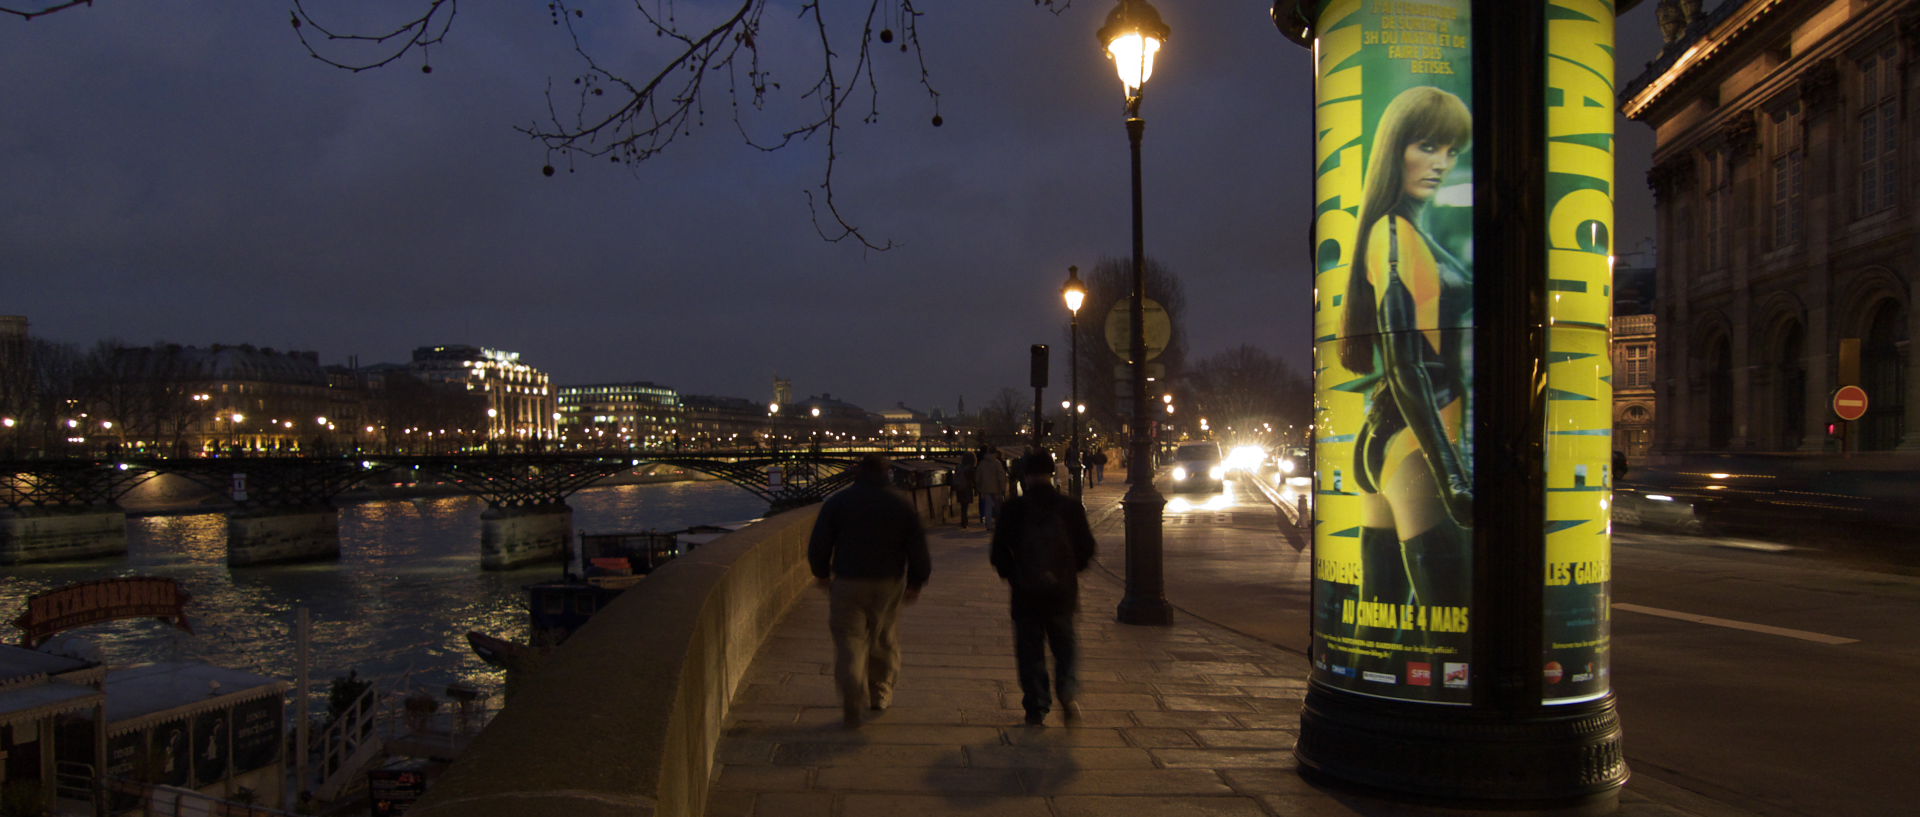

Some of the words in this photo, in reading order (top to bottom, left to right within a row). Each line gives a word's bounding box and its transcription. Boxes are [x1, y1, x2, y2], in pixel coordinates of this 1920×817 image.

[1381, 16, 1395, 29] DE
[1364, 31, 1379, 45] 3H
[1381, 31, 1398, 45] DU
[1440, 34, 1450, 47] ET
[1453, 36, 1466, 48] DE
[1388, 45, 1420, 59] FAIRE
[1422, 46, 1443, 60] DES
[1545, 561, 1571, 586] LES
[1342, 599, 1355, 625] AU
[1357, 595, 1398, 629] CINÉMA
[1400, 604, 1414, 631] LE
[1416, 605, 1427, 631] 4
[1430, 605, 1469, 633] MARS
[1411, 669, 1431, 678] SFR
